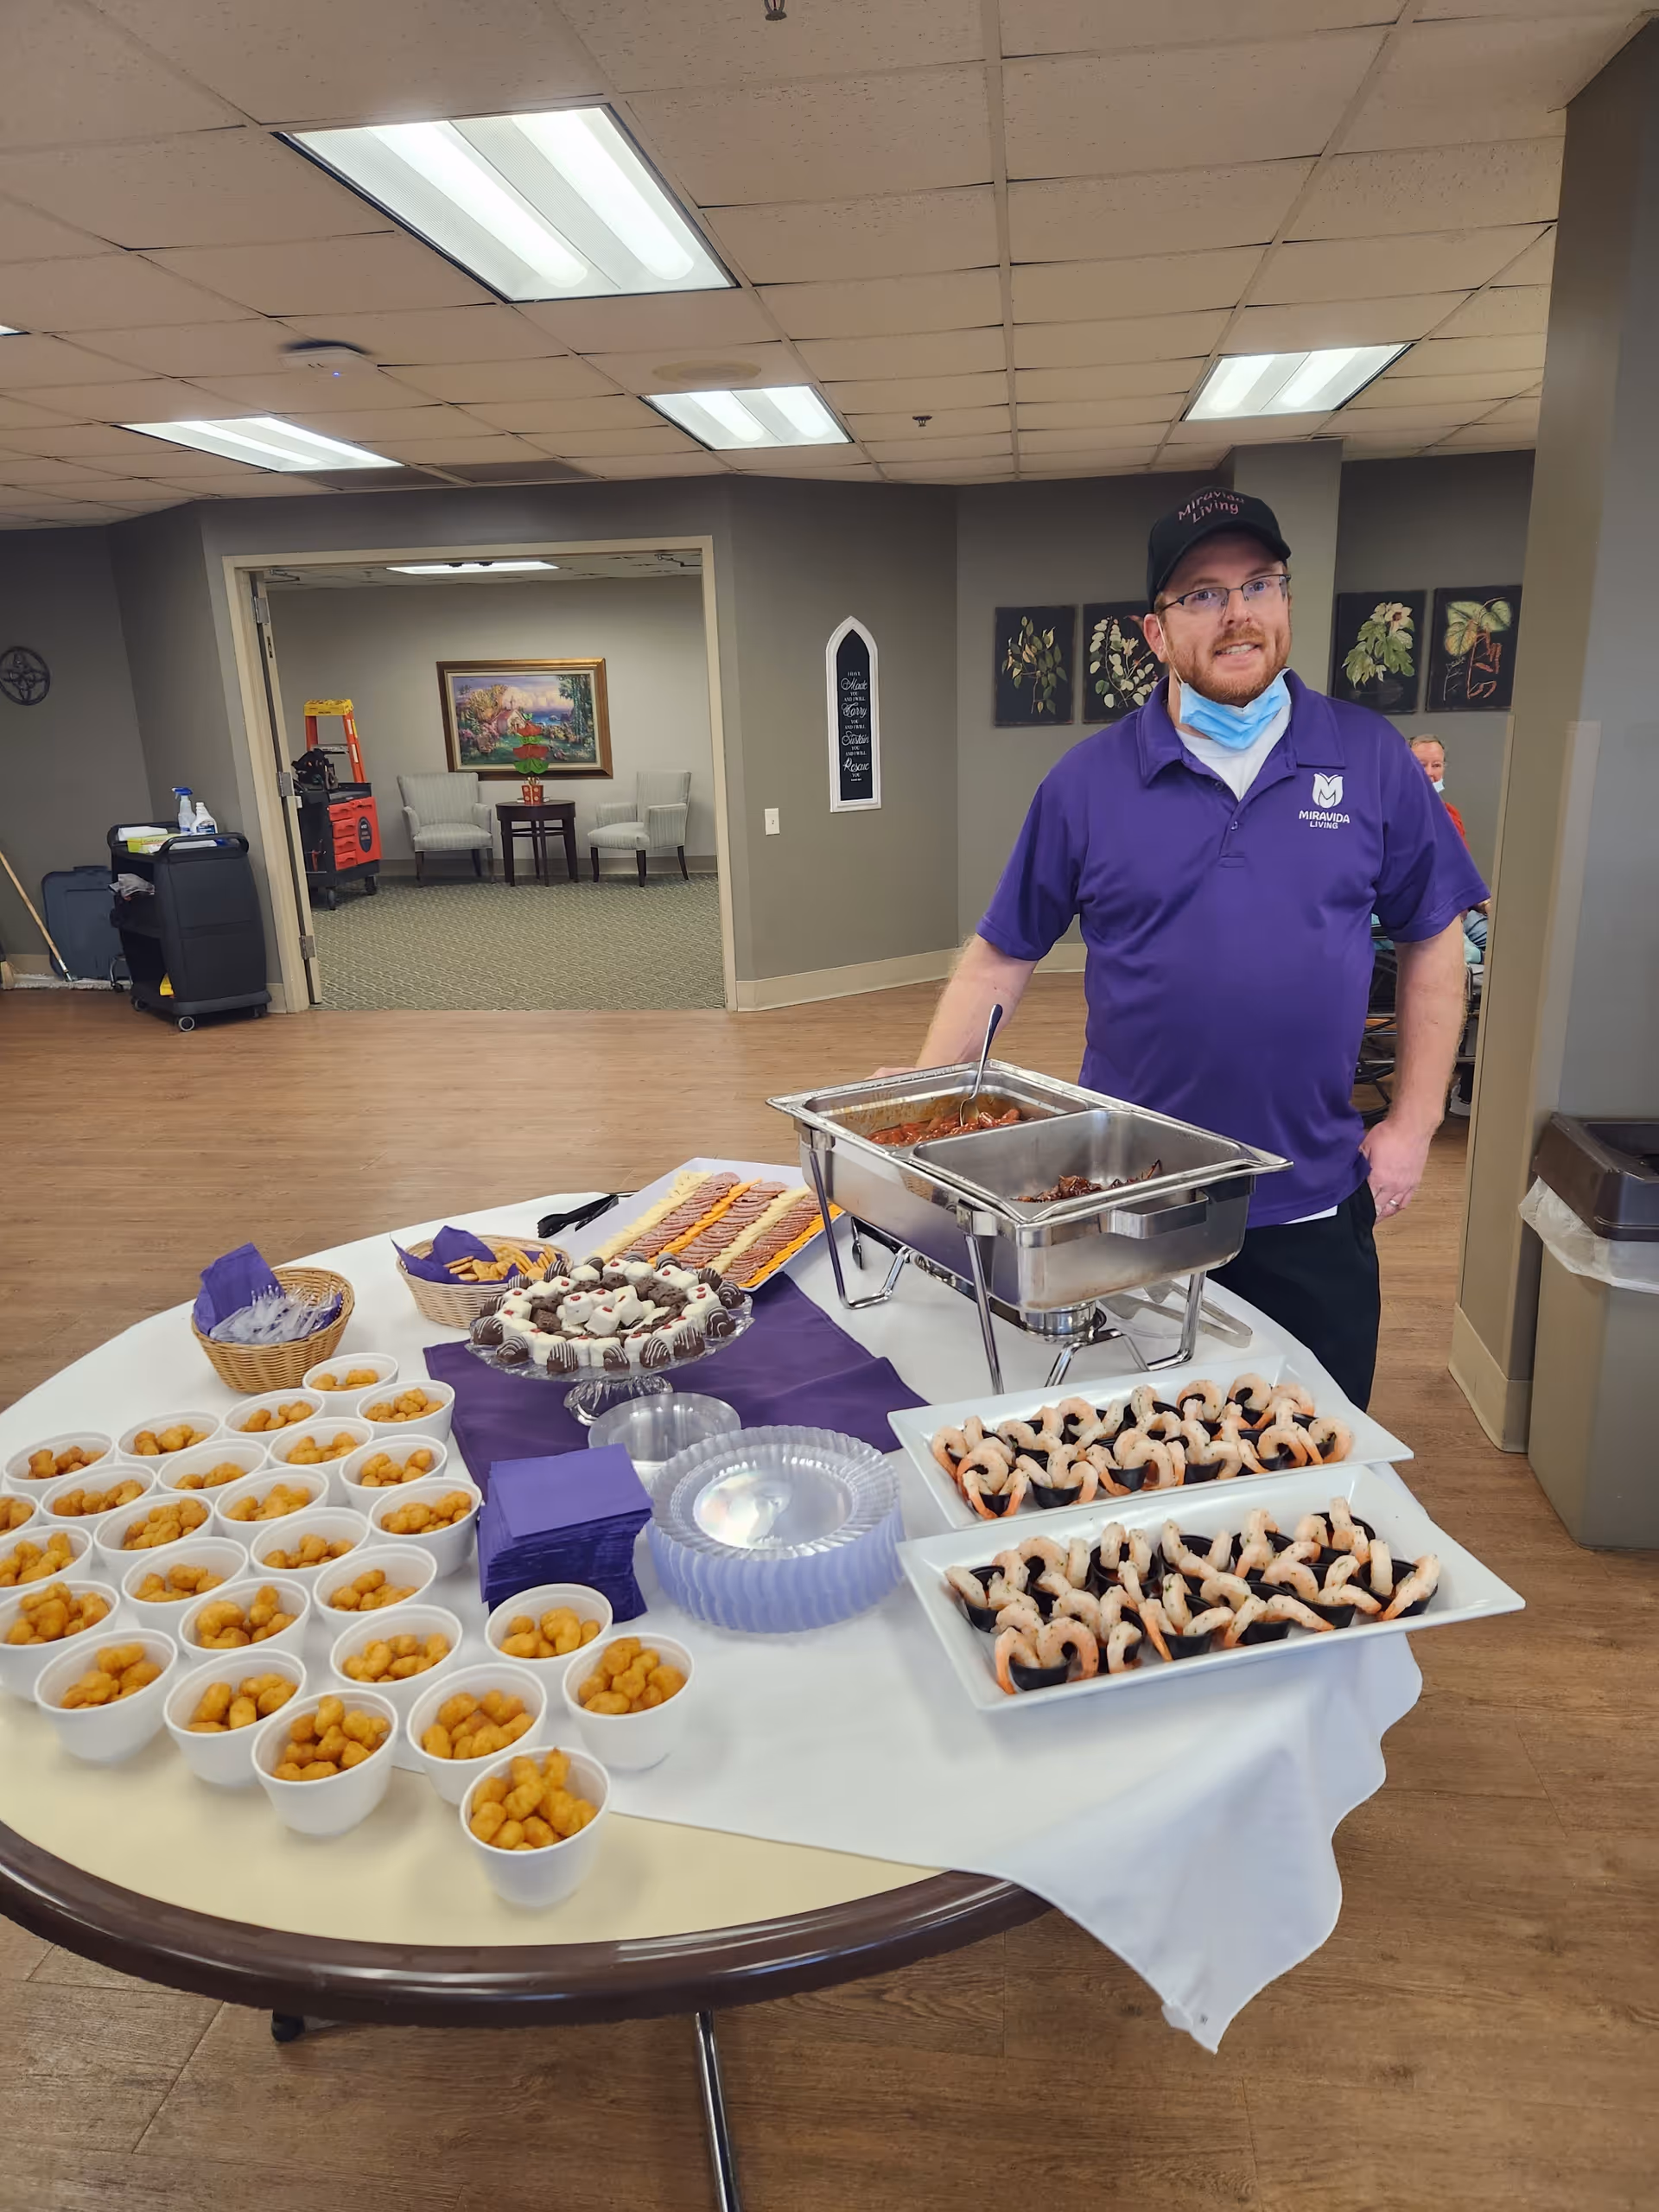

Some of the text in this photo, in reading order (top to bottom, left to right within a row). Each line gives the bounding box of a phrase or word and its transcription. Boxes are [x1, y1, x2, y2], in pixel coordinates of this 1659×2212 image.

[1192, 500, 1239, 524] Living
[1299, 810, 1351, 824] MIRAVIDA
[1309, 820, 1338, 830] LIVING
